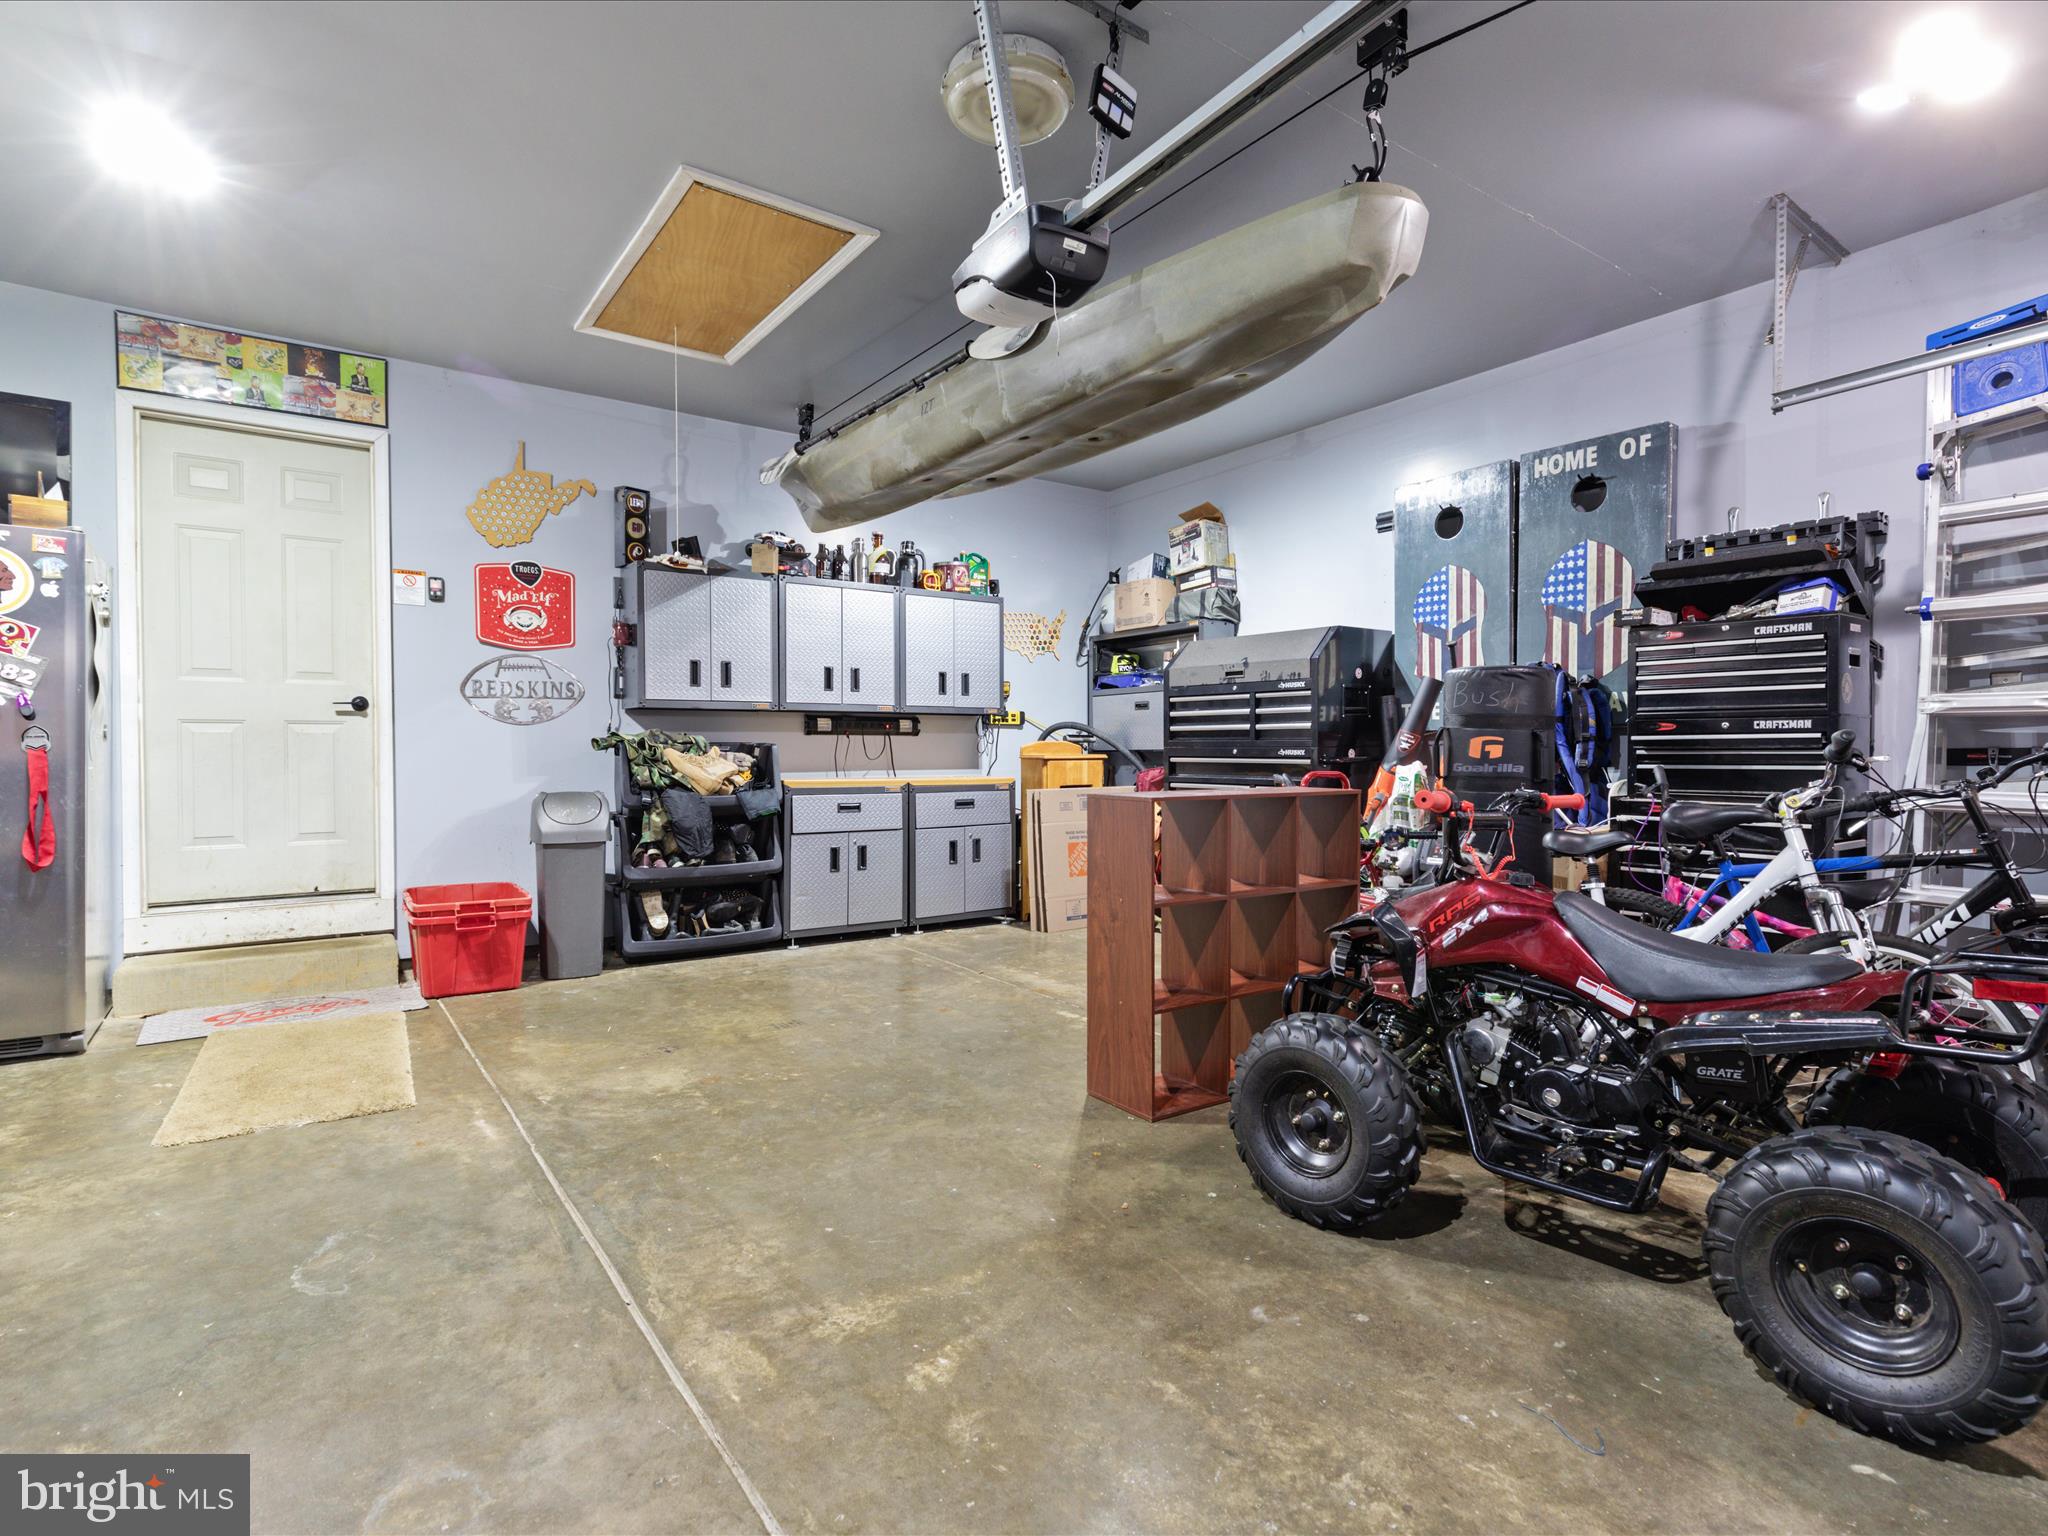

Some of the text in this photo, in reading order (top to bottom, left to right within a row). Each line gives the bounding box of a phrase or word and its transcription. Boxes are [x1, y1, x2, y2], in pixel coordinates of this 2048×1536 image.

[1534, 433, 1652, 478] HOME OF
[492, 589, 560, 608] Mad Elf
[1753, 622, 1813, 635] CRAFTSMAN
[0, 662, 37, 686] 82
[471, 679, 576, 698] REDSKINS
[1401, 703, 1440, 721] TE
[1753, 720, 1812, 729] CRAFTSMAN
[1453, 763, 1525, 773] Goalrilla
[1697, 1066, 1742, 1079] GRATE
